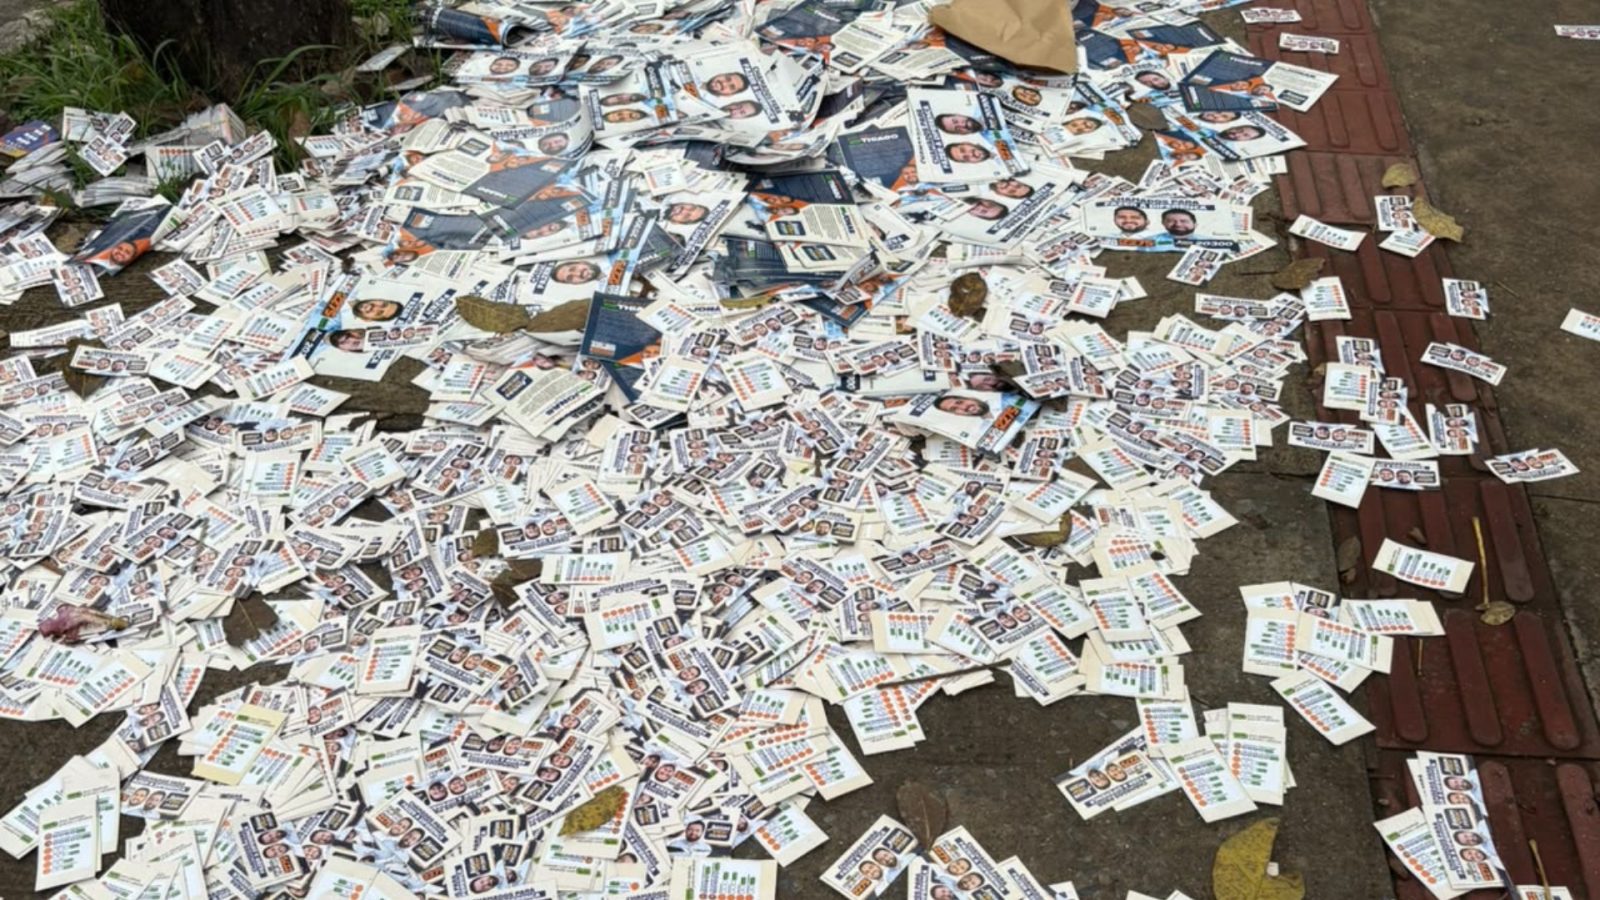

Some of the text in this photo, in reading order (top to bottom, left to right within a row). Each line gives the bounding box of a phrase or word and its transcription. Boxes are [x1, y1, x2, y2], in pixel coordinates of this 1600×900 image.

[751, 65, 782, 114] CHAMADOS PARA
[915, 108, 927, 127] PARA
[860, 132, 898, 144] THIAGO
[921, 127, 939, 165] CHAMADOS
